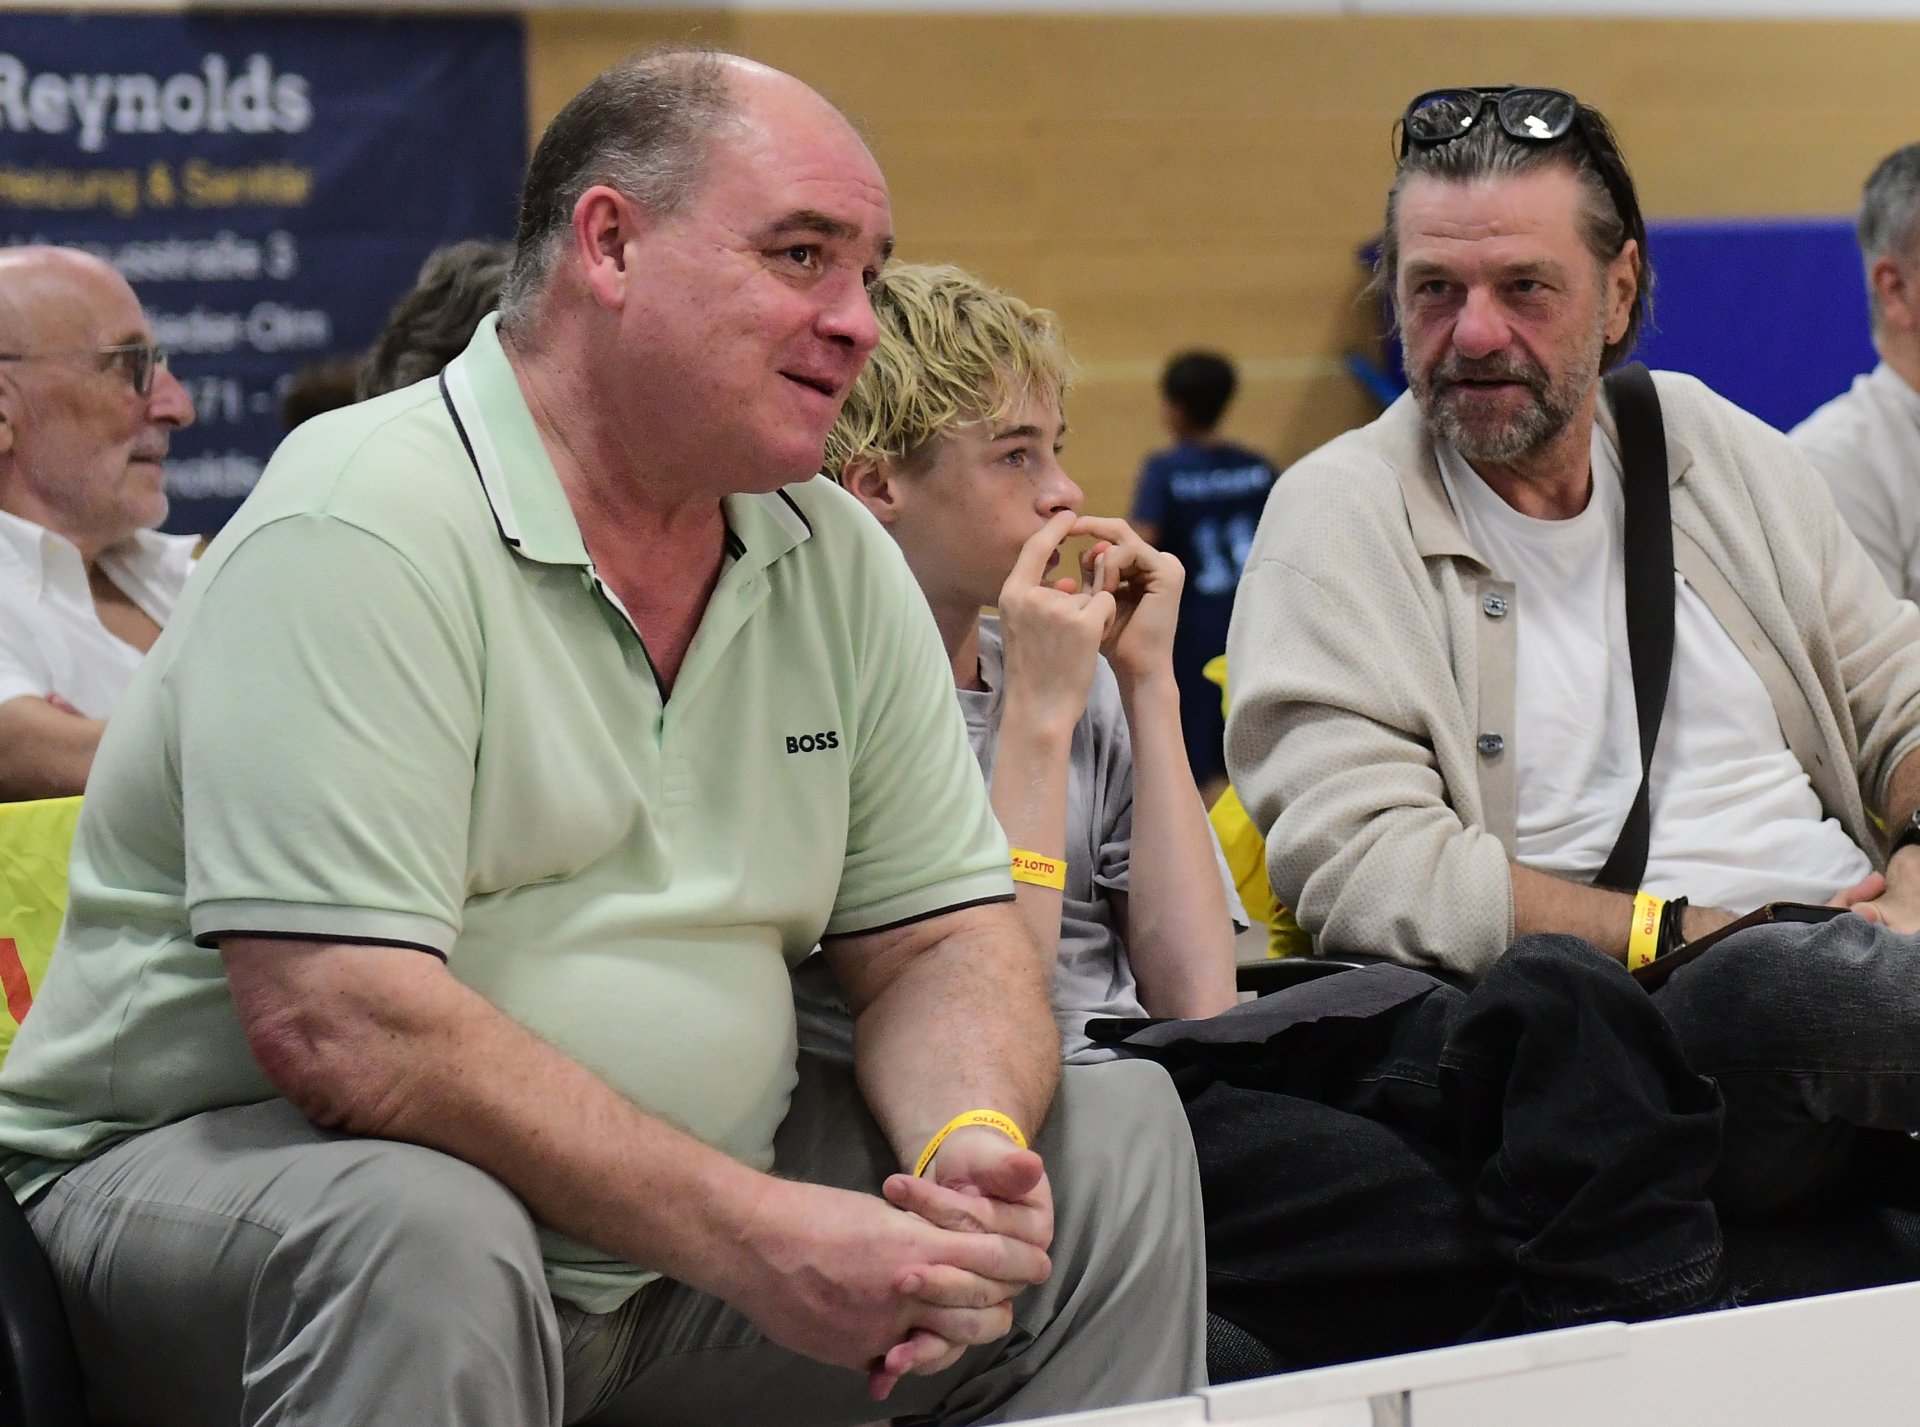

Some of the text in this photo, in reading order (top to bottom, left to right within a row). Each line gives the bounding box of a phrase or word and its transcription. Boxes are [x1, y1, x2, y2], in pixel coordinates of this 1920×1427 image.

[786, 731, 839, 754] BOSS
[1024, 860, 1055, 873] LOTTO
[1645, 907, 1656, 935] LOTTO
[973, 1116, 1010, 1130] LOTTO
